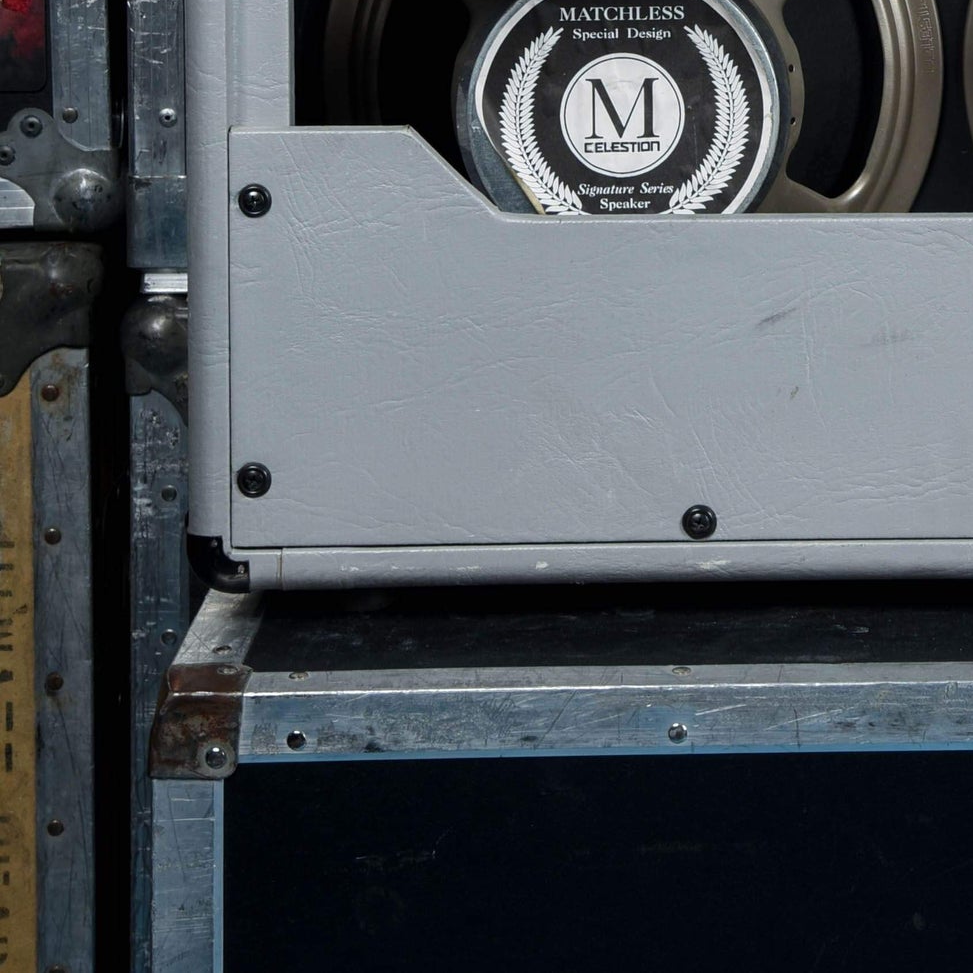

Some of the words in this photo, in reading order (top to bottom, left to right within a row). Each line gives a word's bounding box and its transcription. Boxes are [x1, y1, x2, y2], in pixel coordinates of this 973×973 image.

[558, 5, 686, 23] MATCHLESS
[572, 28, 619, 42] Special
[627, 28, 672, 41] Design
[584, 77, 660, 139] M
[584, 140, 661, 154] CELESTION
[577, 183, 635, 198] Signature
[639, 182, 675, 195] Series
[599, 197, 651, 212] Speaker
